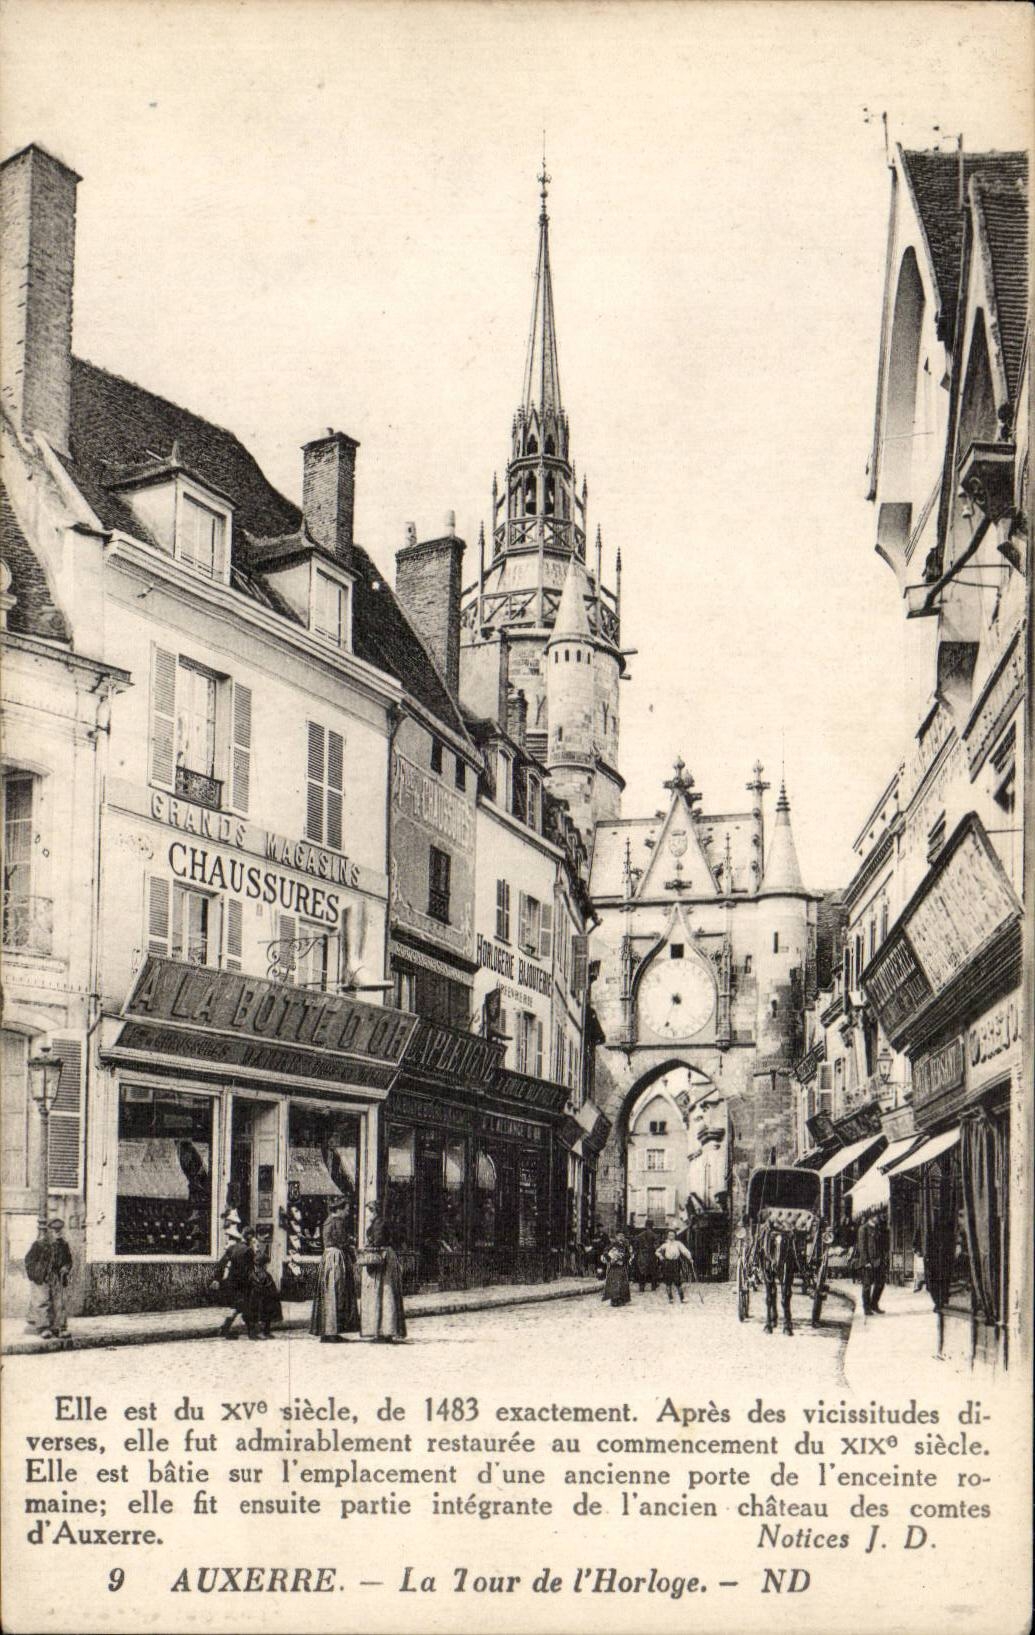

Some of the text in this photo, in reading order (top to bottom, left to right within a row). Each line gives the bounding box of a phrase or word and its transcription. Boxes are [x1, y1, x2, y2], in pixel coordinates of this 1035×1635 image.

[151, 792, 360, 888] GRANDS MAGASINS
[168, 841, 340, 924] CHAUSSURES
[129, 960, 411, 1060] A LA BOTTE D'OR
[476, 934, 515, 980] HORLOGERIE
[518, 957, 552, 998] BIJOUTERIE
